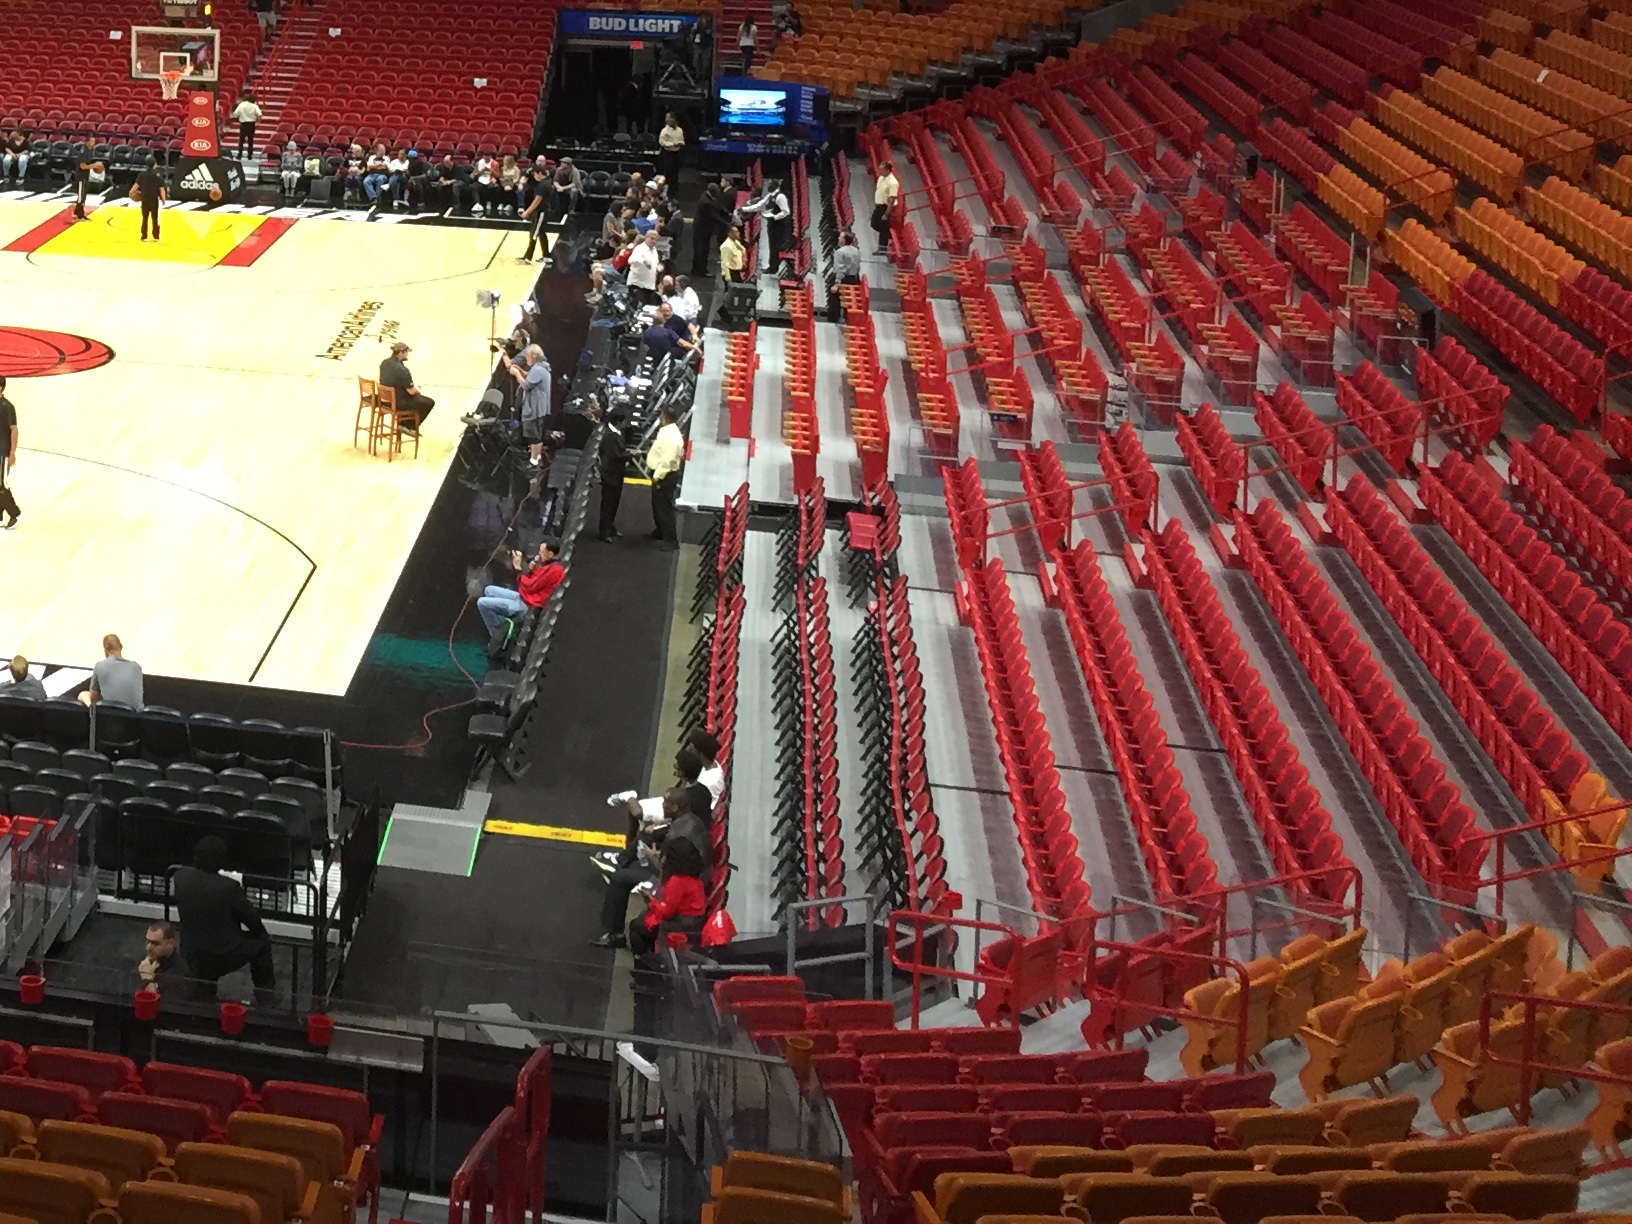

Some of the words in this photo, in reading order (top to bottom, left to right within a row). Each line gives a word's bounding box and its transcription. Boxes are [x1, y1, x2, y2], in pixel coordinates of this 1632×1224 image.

[589, 16, 627, 32] BUD
[629, 17, 681, 33] LIGHT
[192, 118, 209, 126] KIA
[190, 140, 209, 149] KIA
[181, 179, 219, 190] adidas
